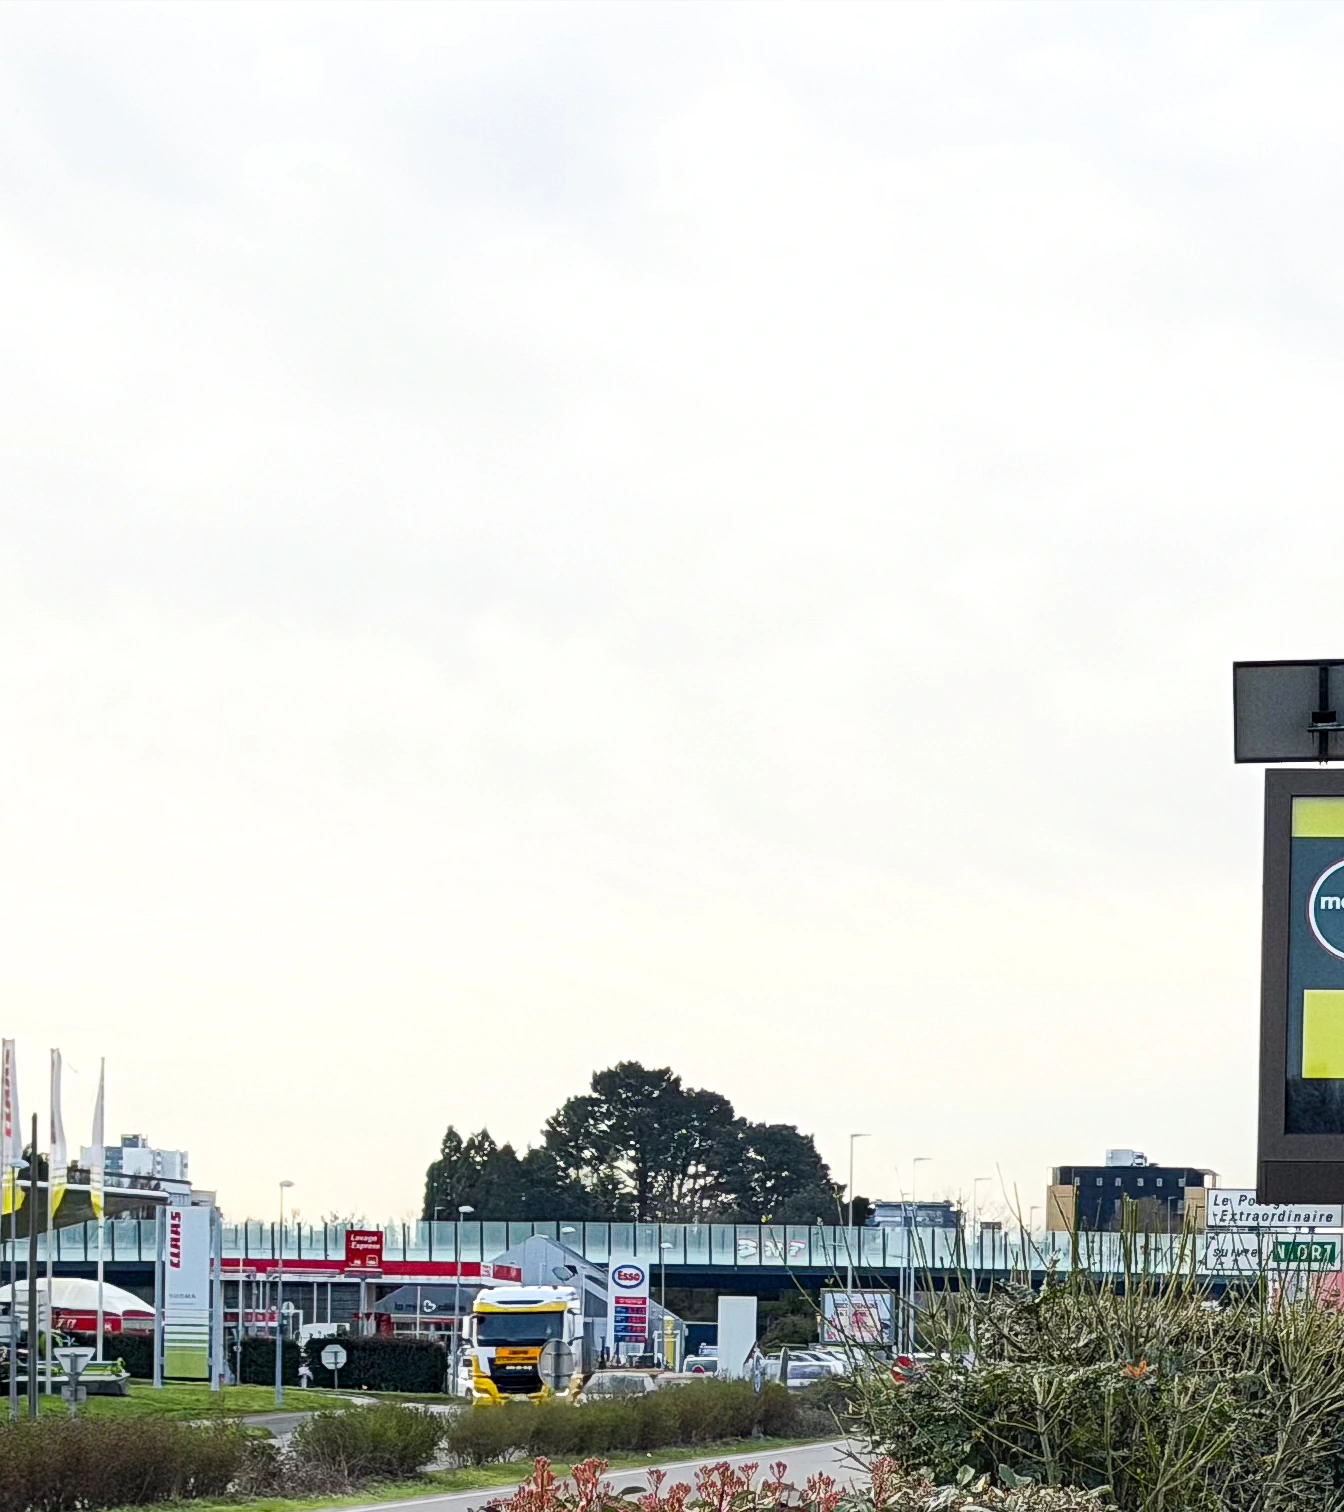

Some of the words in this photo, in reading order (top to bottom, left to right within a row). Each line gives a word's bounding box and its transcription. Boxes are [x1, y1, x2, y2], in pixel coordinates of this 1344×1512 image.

[1213, 1193, 1230, 1207] Le
[1219, 1209, 1334, 1223] Extraordinaire
[169, 1211, 182, 1269] CLAAS
[1276, 1244, 1333, 1260] NORT
[617, 1270, 641, 1282] Esso
